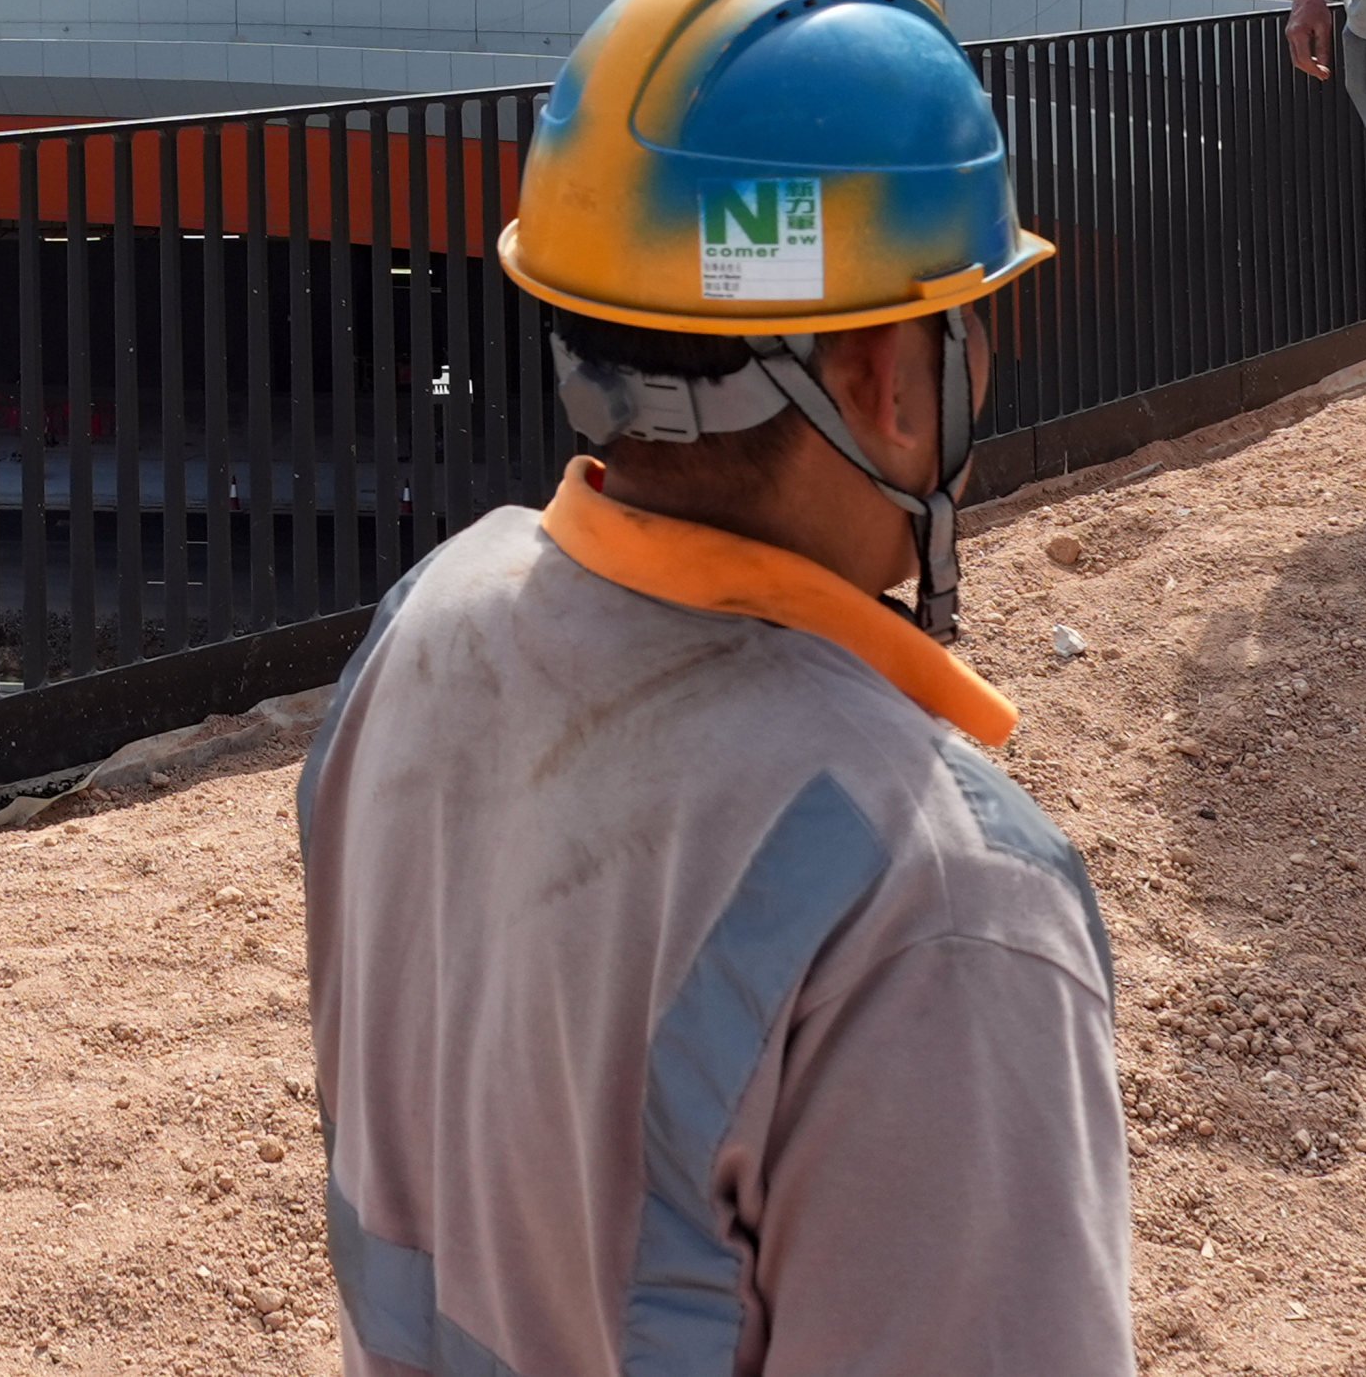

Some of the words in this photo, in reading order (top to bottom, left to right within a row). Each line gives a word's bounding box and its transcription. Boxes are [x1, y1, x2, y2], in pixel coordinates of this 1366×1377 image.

[705, 180, 779, 245] N
[786, 235, 817, 246] ew
[705, 247, 780, 258] comer
